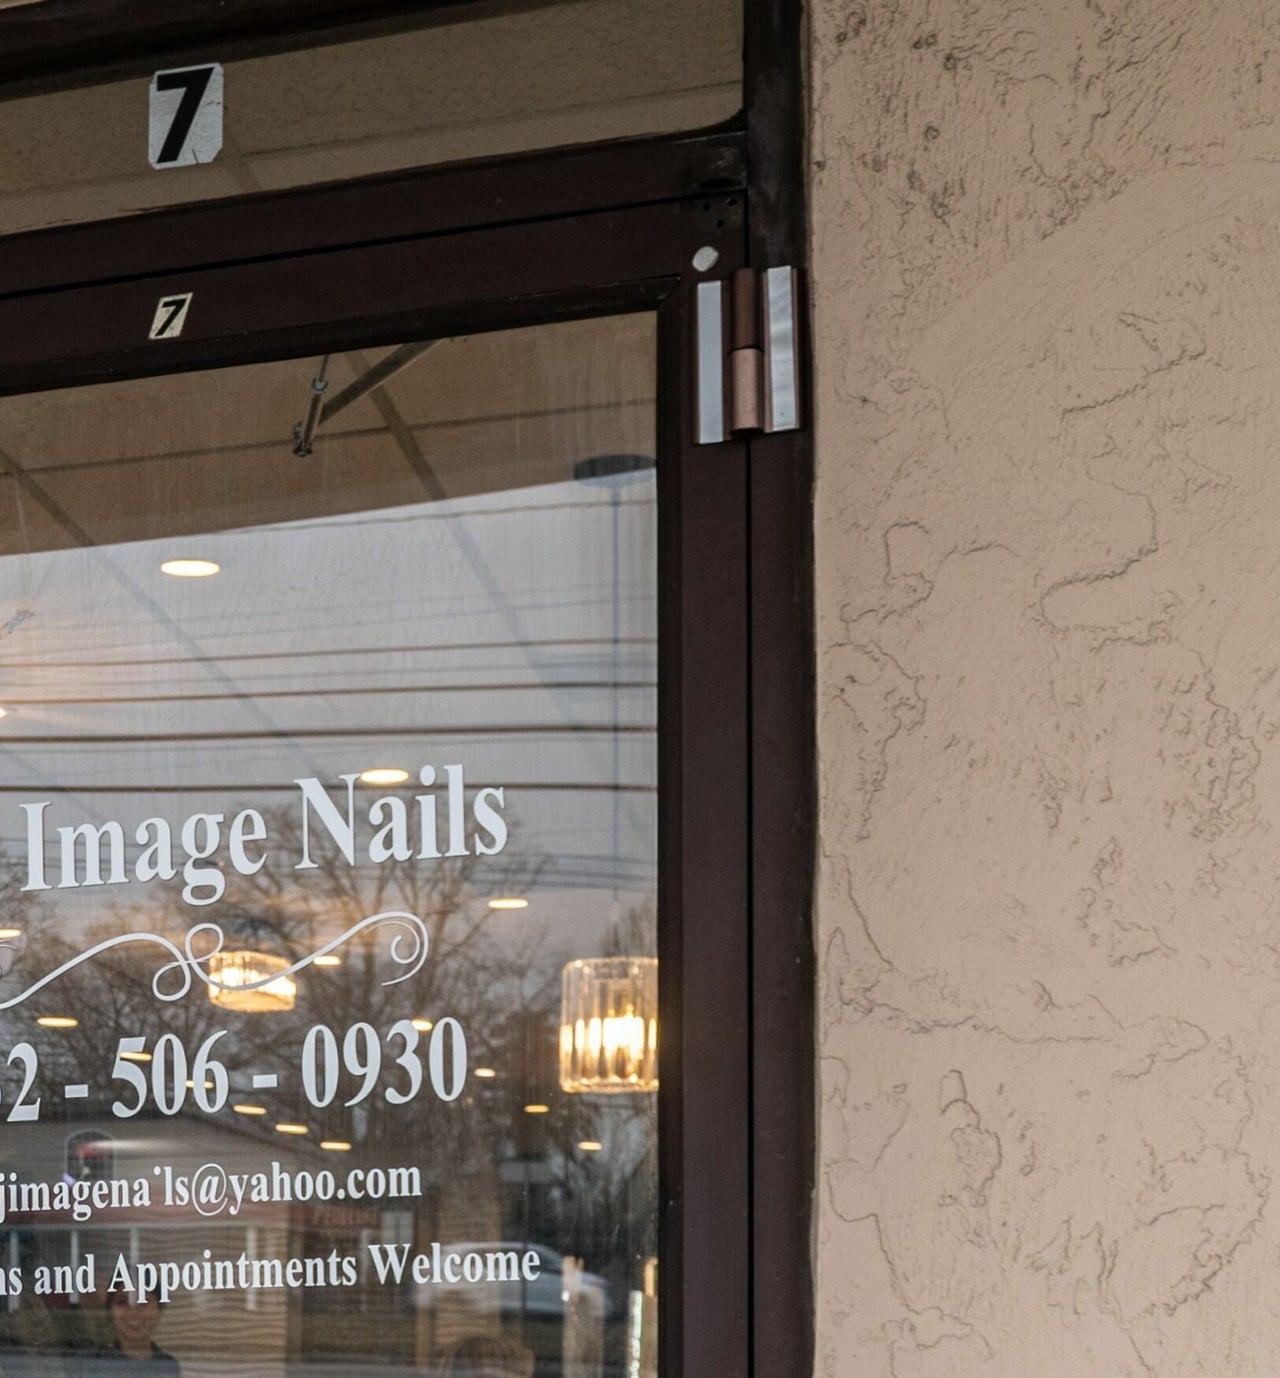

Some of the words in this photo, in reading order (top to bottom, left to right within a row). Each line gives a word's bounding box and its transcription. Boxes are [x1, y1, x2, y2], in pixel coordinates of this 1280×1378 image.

[156, 66, 216, 165] 7
[154, 298, 188, 337] 7
[19, 801, 269, 907] Image
[293, 763, 509, 872] Nails
[111, 1030, 229, 1118] 506
[301, 1016, 468, 1108] 0930
[34, 1253, 97, 1295] and
[107, 1241, 357, 1304] Appointments
[367, 1242, 541, 1286] Welcome
